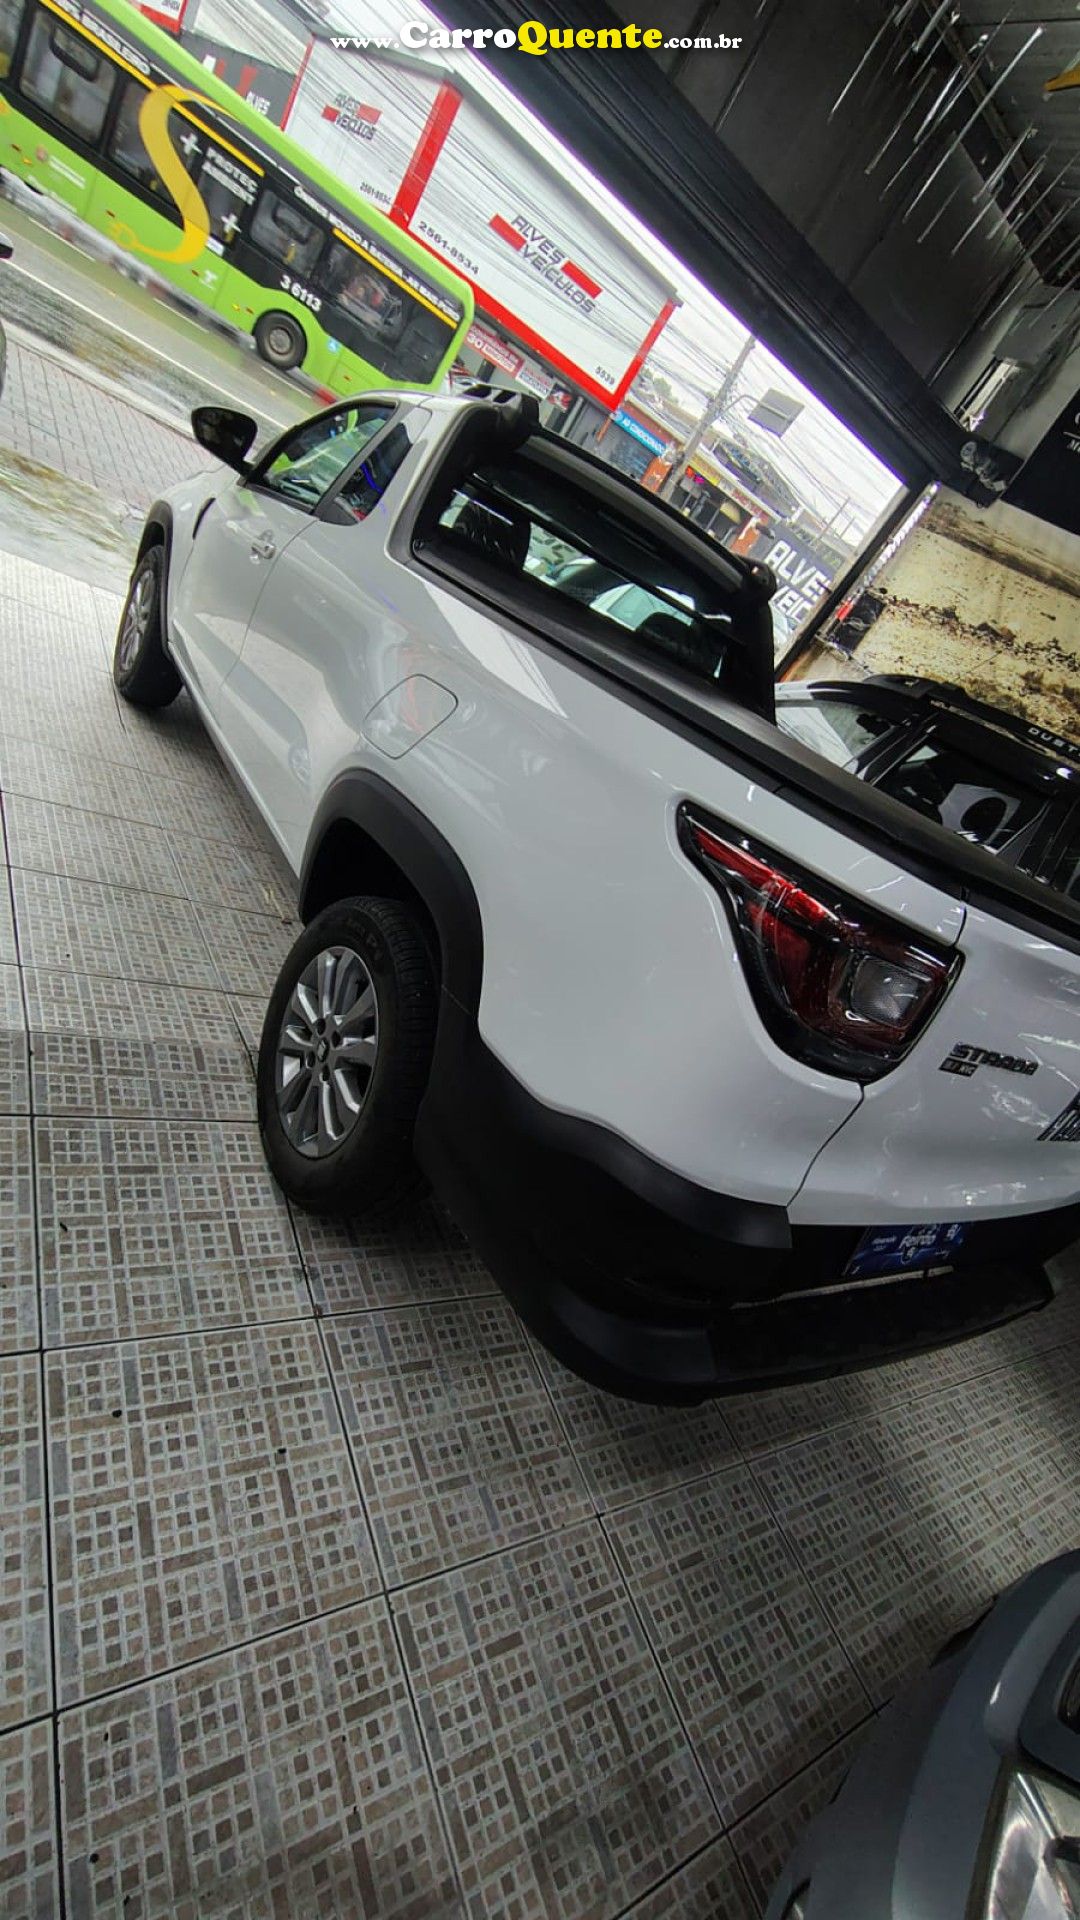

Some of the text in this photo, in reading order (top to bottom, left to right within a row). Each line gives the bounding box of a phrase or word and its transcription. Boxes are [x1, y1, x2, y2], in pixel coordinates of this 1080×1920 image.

[417, 220, 480, 276] 2561-8534
[510, 214, 567, 265] ALVES
[763, 539, 833, 602] ALVE
[1028, 726, 1080, 758] DUST
